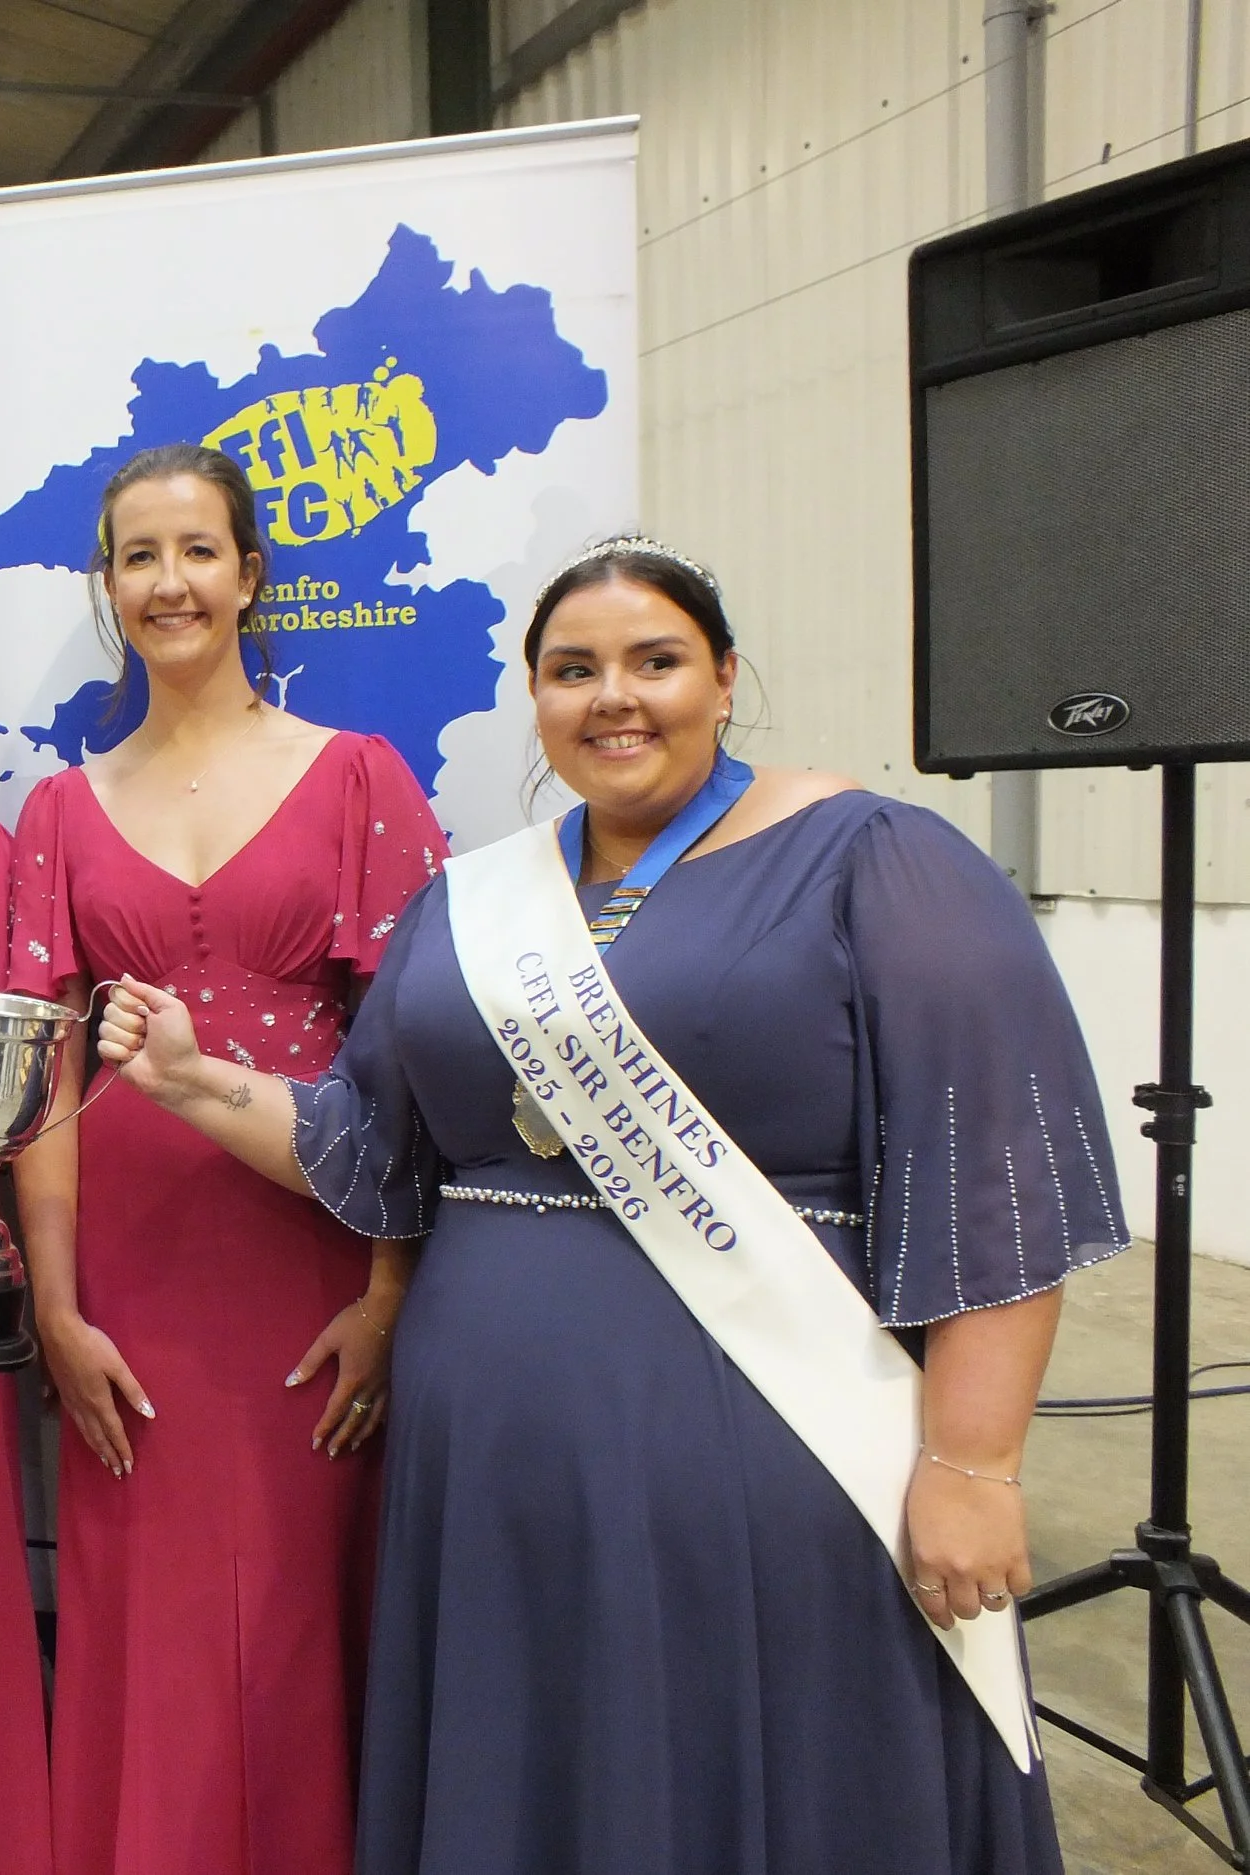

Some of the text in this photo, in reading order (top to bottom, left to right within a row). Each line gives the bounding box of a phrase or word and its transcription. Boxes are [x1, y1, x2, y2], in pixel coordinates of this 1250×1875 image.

[240, 601, 417, 634] brokeshire
[497, 1018, 564, 1101] 2025
[572, 1134, 650, 1221] 2026
[555, 1034, 609, 1103] SIR
[602, 1100, 737, 1252] BENFRO
[567, 963, 728, 1169] BRENHINES
